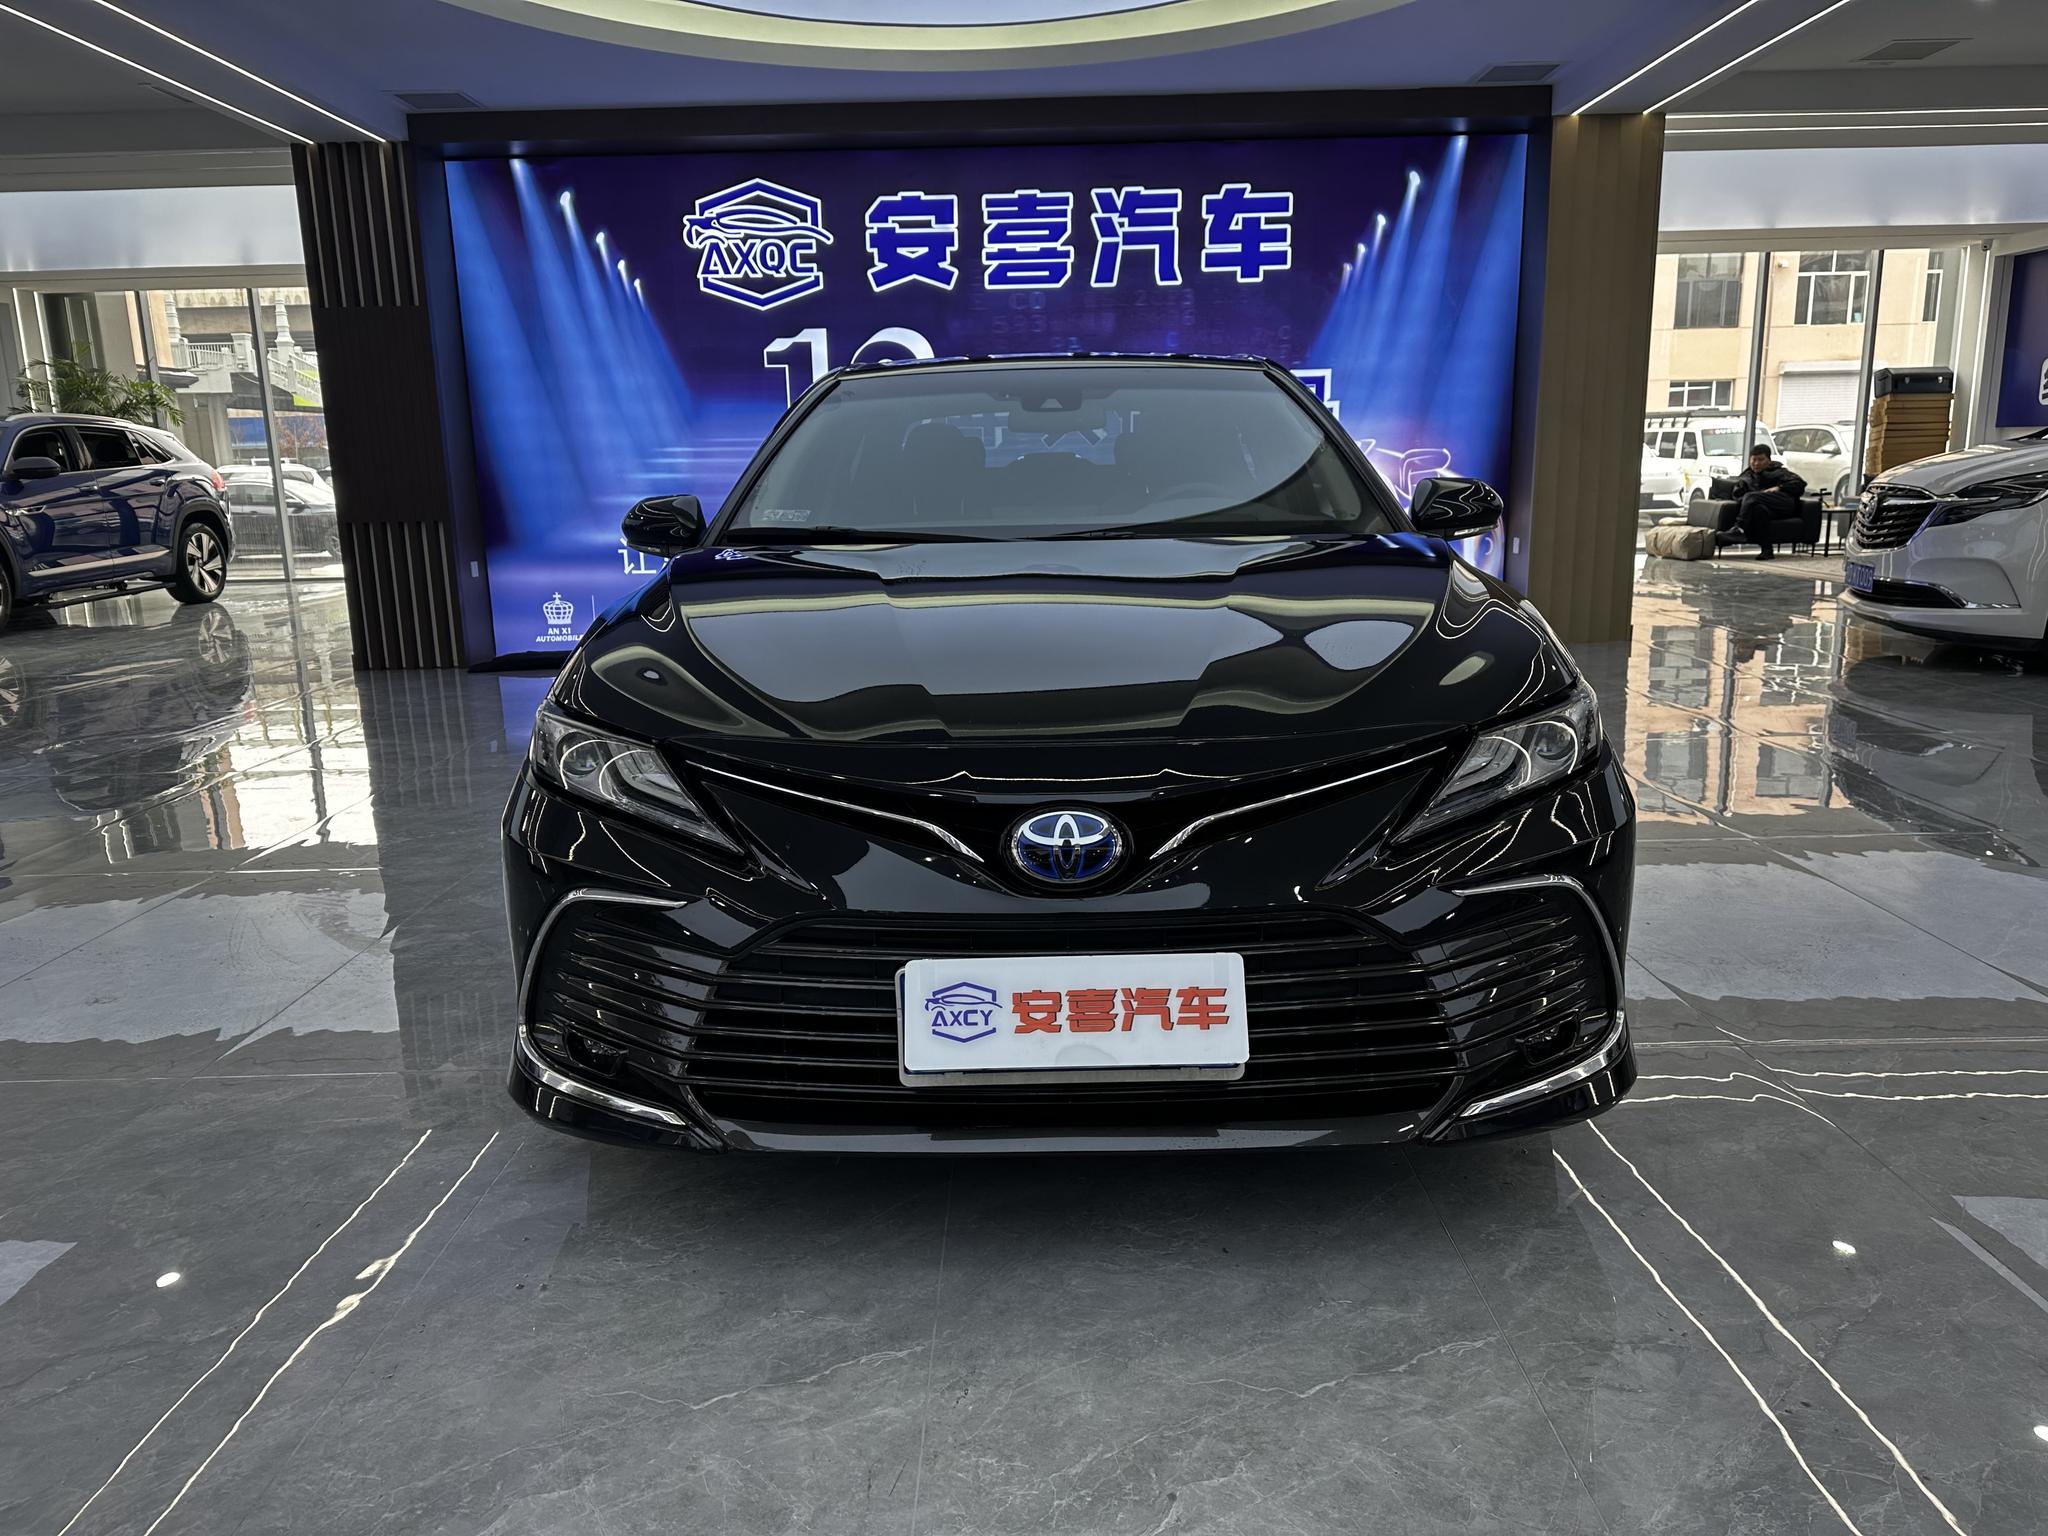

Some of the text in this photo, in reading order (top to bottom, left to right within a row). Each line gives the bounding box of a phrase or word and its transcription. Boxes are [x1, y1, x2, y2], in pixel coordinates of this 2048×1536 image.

[698, 237, 819, 278] AXQC
[866, 183, 1294, 291] 安喜汽车
[548, 627, 571, 635] AN XI
[931, 1009, 993, 1028] AXCY
[1011, 986, 1230, 1034] 安喜汽车
